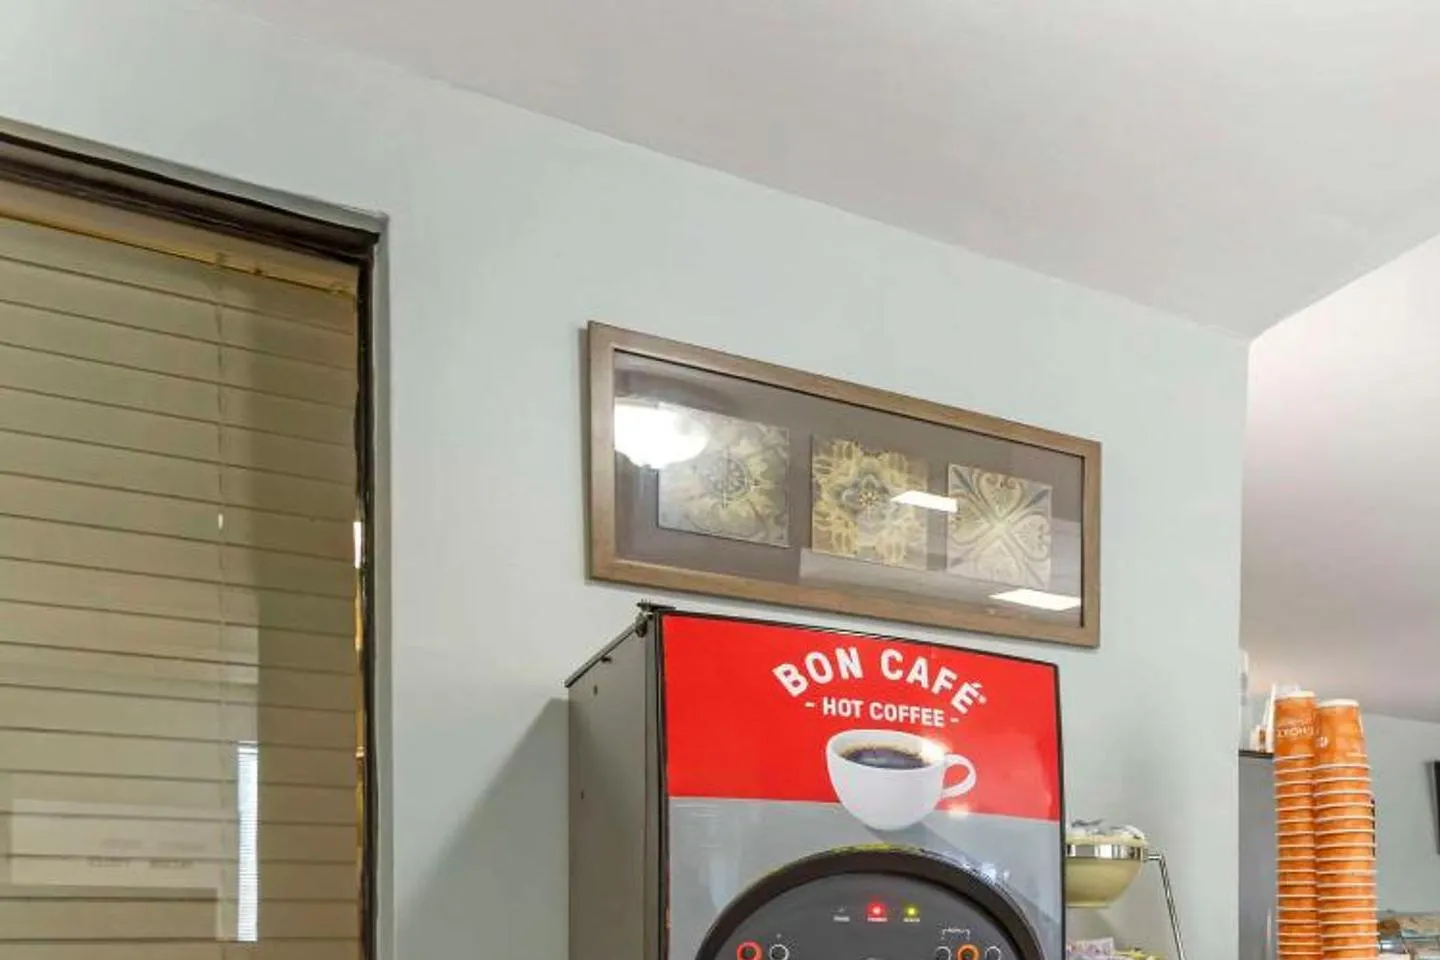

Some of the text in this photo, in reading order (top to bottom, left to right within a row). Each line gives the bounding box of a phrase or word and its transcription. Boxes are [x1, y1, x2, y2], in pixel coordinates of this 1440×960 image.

[772, 647, 984, 714] BON CAFÉ
[822, 696, 945, 728] HOT COFFEE
